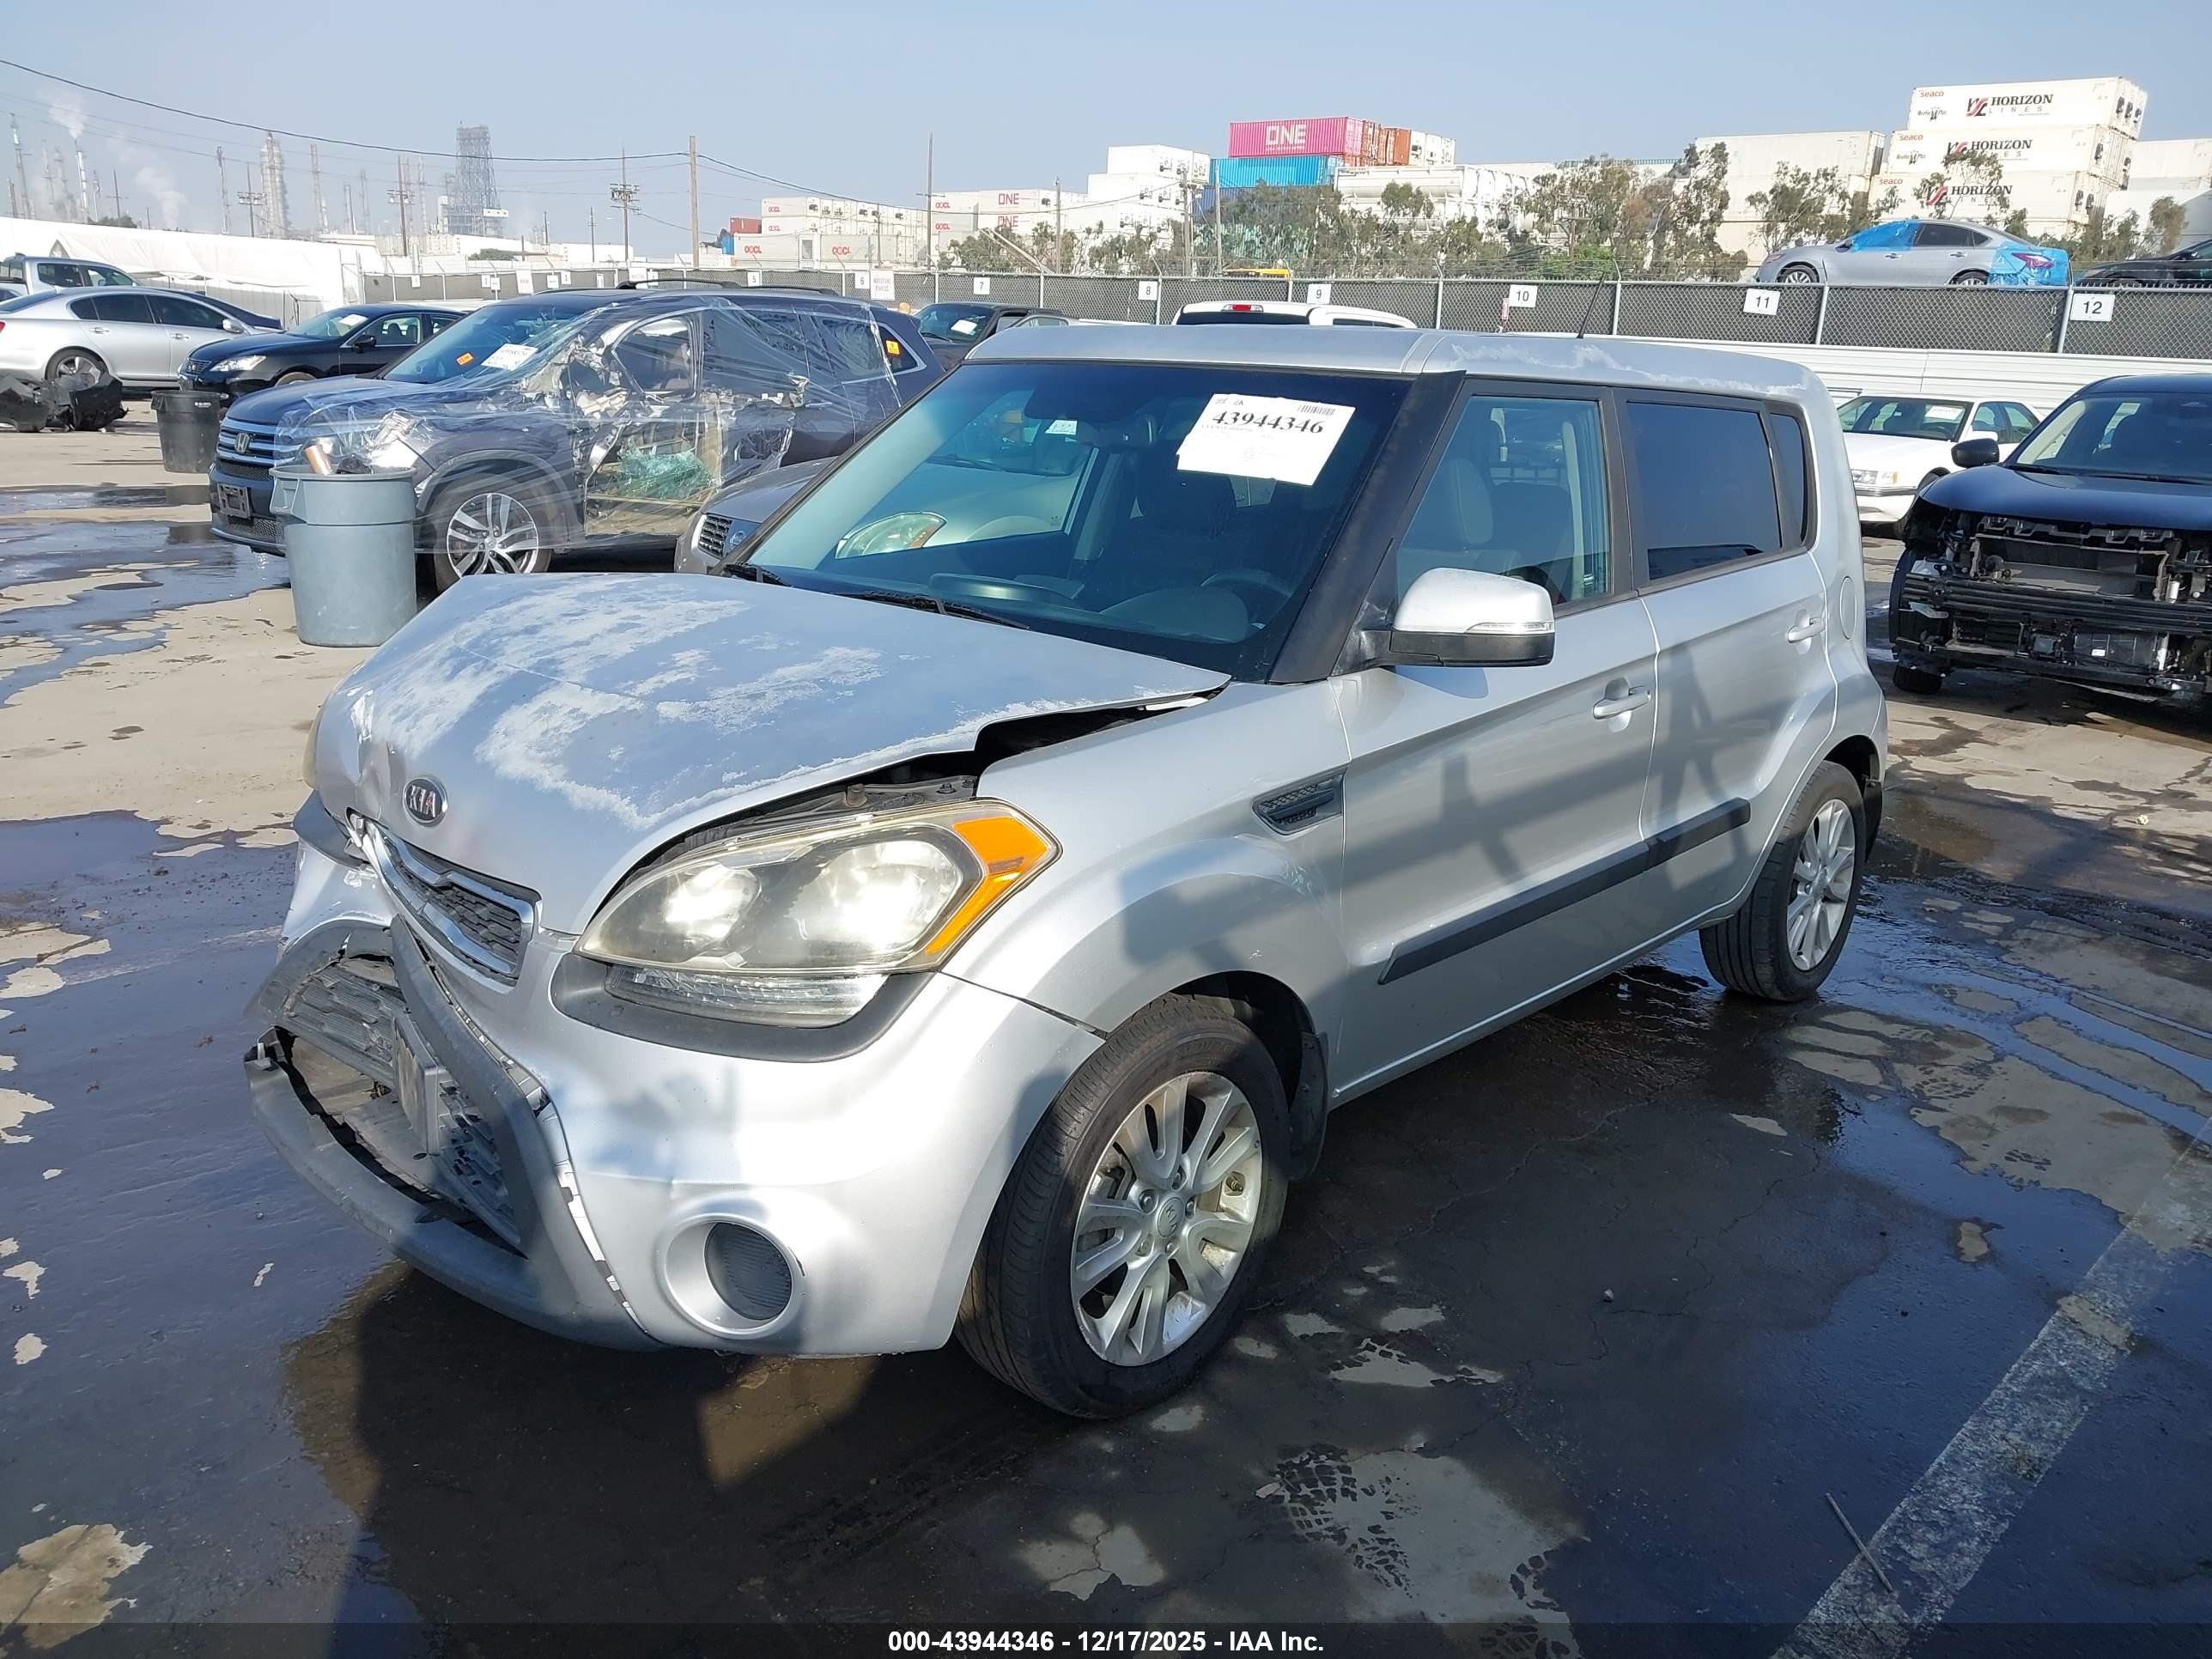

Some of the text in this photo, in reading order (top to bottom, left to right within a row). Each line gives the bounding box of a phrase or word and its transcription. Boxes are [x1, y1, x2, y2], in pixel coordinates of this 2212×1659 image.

[1990, 94, 2054, 106] HORIZON
[1989, 105, 2043, 114] LINES
[1265, 124, 1306, 145] ONE
[1971, 139, 2033, 150] HORIZON
[1951, 185, 2013, 195] HORIZON
[998, 193, 1019, 204] ONE
[997, 216, 1018, 228] ONE
[744, 246, 763, 254] OOCL
[751, 275, 757, 283] 5
[860, 276, 865, 285] 6
[979, 281, 984, 290] 7
[1146, 285, 1151, 295] 8
[1316, 289, 1322, 299] 9
[1516, 290, 1529, 302] 10
[1755, 295, 1770, 308] 11
[2082, 301, 2103, 314] 12
[1212, 410, 1326, 434] 43944346
[410, 784, 436, 818] KIA
